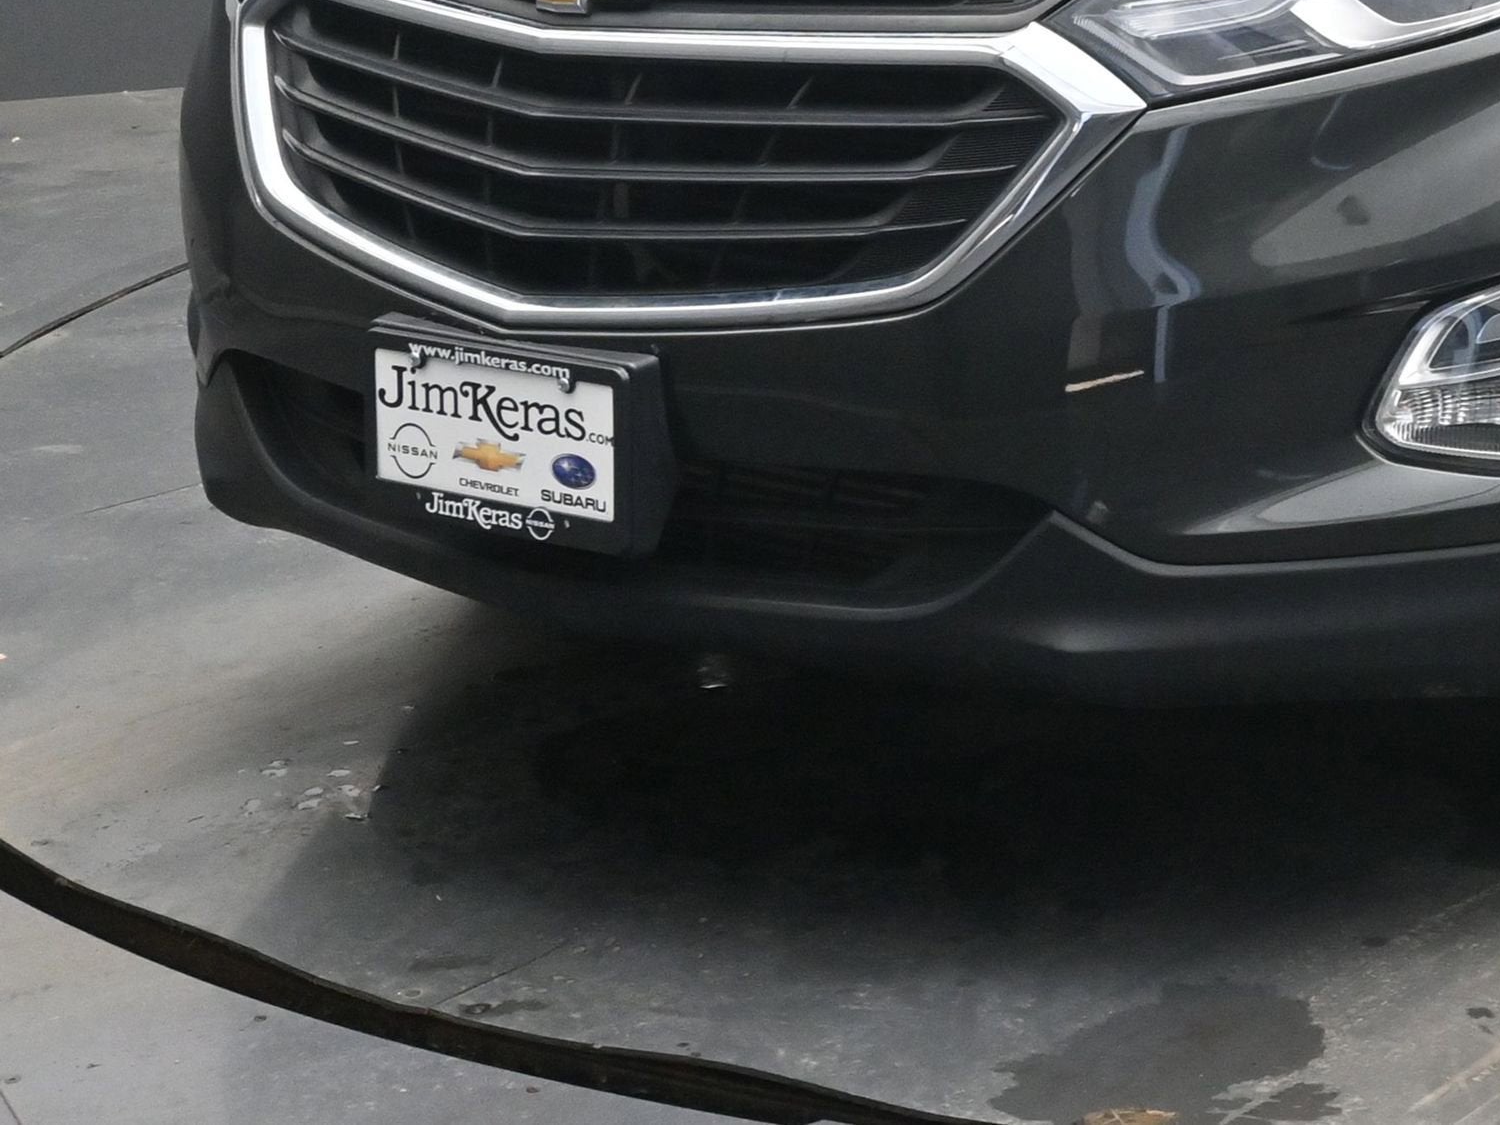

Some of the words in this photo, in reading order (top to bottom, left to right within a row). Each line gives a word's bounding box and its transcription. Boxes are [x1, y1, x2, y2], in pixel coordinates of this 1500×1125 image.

[408, 342, 571, 379] www.jimkeras.com
[387, 442, 438, 460] NISSAN
[458, 477, 519, 497] CHEVROLET
[425, 492, 523, 530] JimKeras
[540, 489, 606, 513] SUBARU
